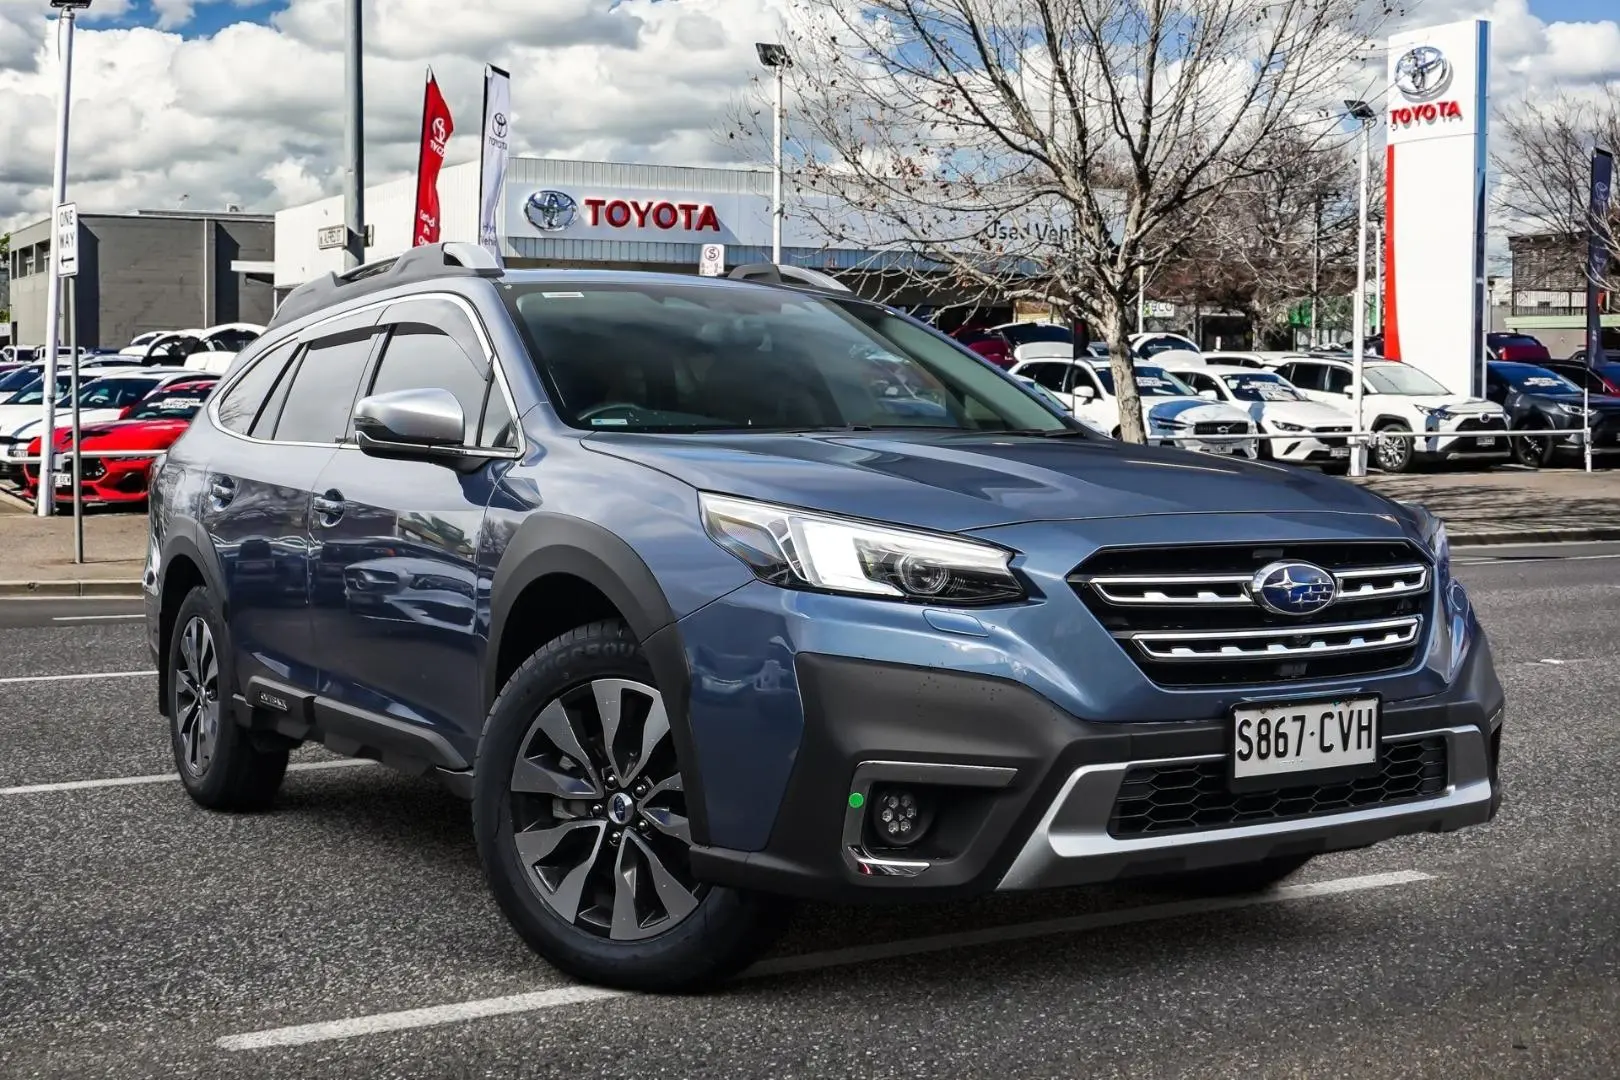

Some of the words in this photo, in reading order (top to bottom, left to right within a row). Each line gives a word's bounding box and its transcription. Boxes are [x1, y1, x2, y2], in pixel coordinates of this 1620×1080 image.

[1389, 101, 1462, 124] TOYOTA
[60, 209, 74, 227] ONE
[584, 199, 721, 232] TOYOTA
[59, 231, 76, 249] WAY
